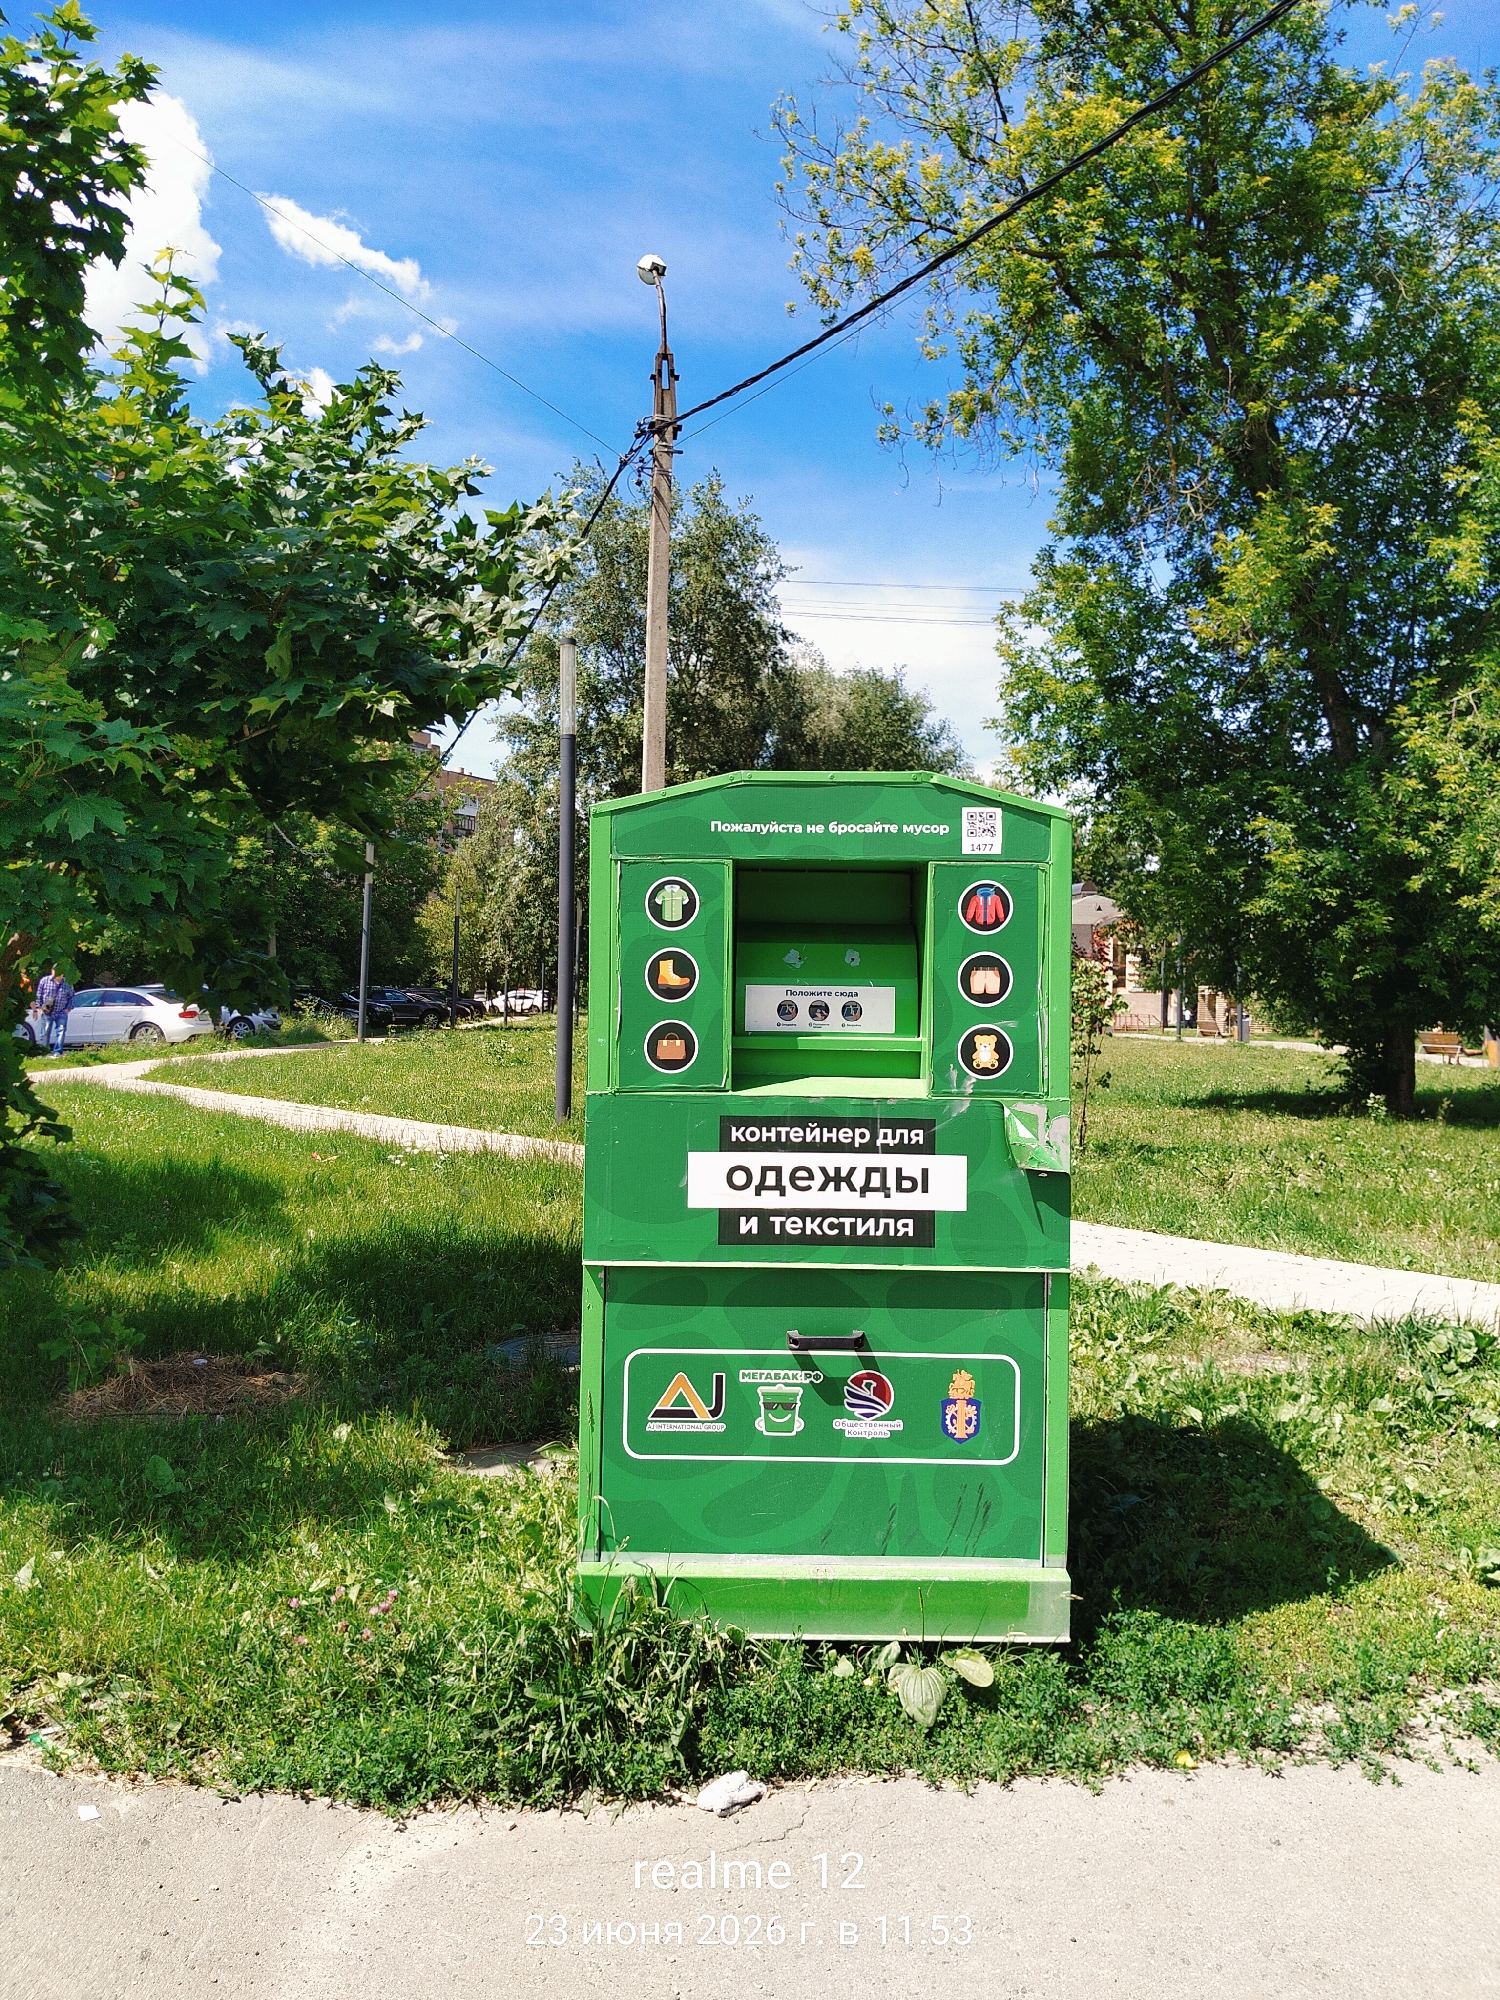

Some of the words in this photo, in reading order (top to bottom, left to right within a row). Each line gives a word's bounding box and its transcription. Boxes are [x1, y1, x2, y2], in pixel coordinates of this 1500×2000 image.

[710, 820, 802, 835] Пожалуйста
[806, 824, 825, 834] не
[828, 821, 899, 835] бросайте
[902, 824, 950, 835] мусор
[970, 843, 994, 852] 1477
[785, 989, 833, 997] Положите
[834, 990, 859, 998] сюда
[731, 1123, 870, 1147] контейнер
[876, 1128, 924, 1147] для
[726, 1165, 928, 1198] одежды
[739, 1216, 758, 1235] и
[769, 1216, 914, 1237] текстиля
[741, 1371, 822, 1382] МЕГАБАК.РФ
[834, 1420, 902, 1429] Общественный
[847, 1429, 890, 1438] Контроль
